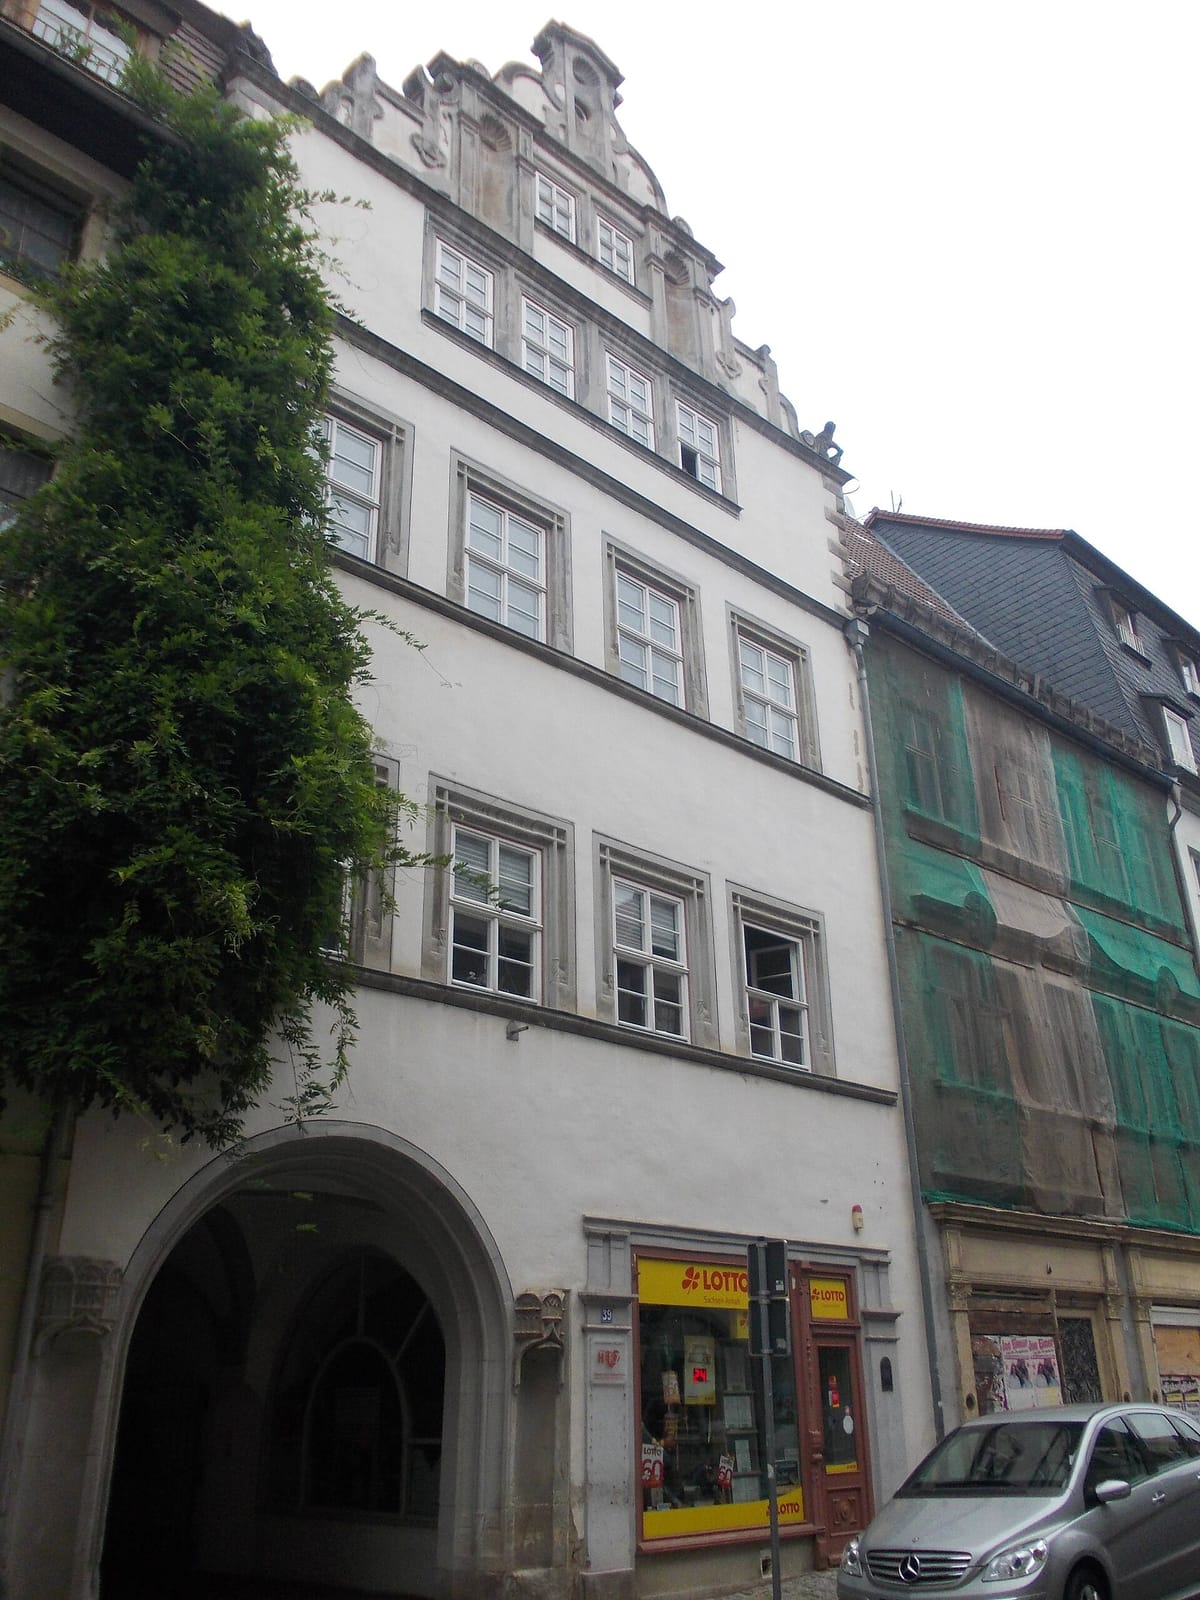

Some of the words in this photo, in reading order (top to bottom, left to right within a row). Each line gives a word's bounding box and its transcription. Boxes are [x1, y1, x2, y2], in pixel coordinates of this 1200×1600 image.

[703, 1270, 749, 1293] LOTTO
[820, 1289, 845, 1301] LOTTO
[602, 1310, 612, 1321] 39
